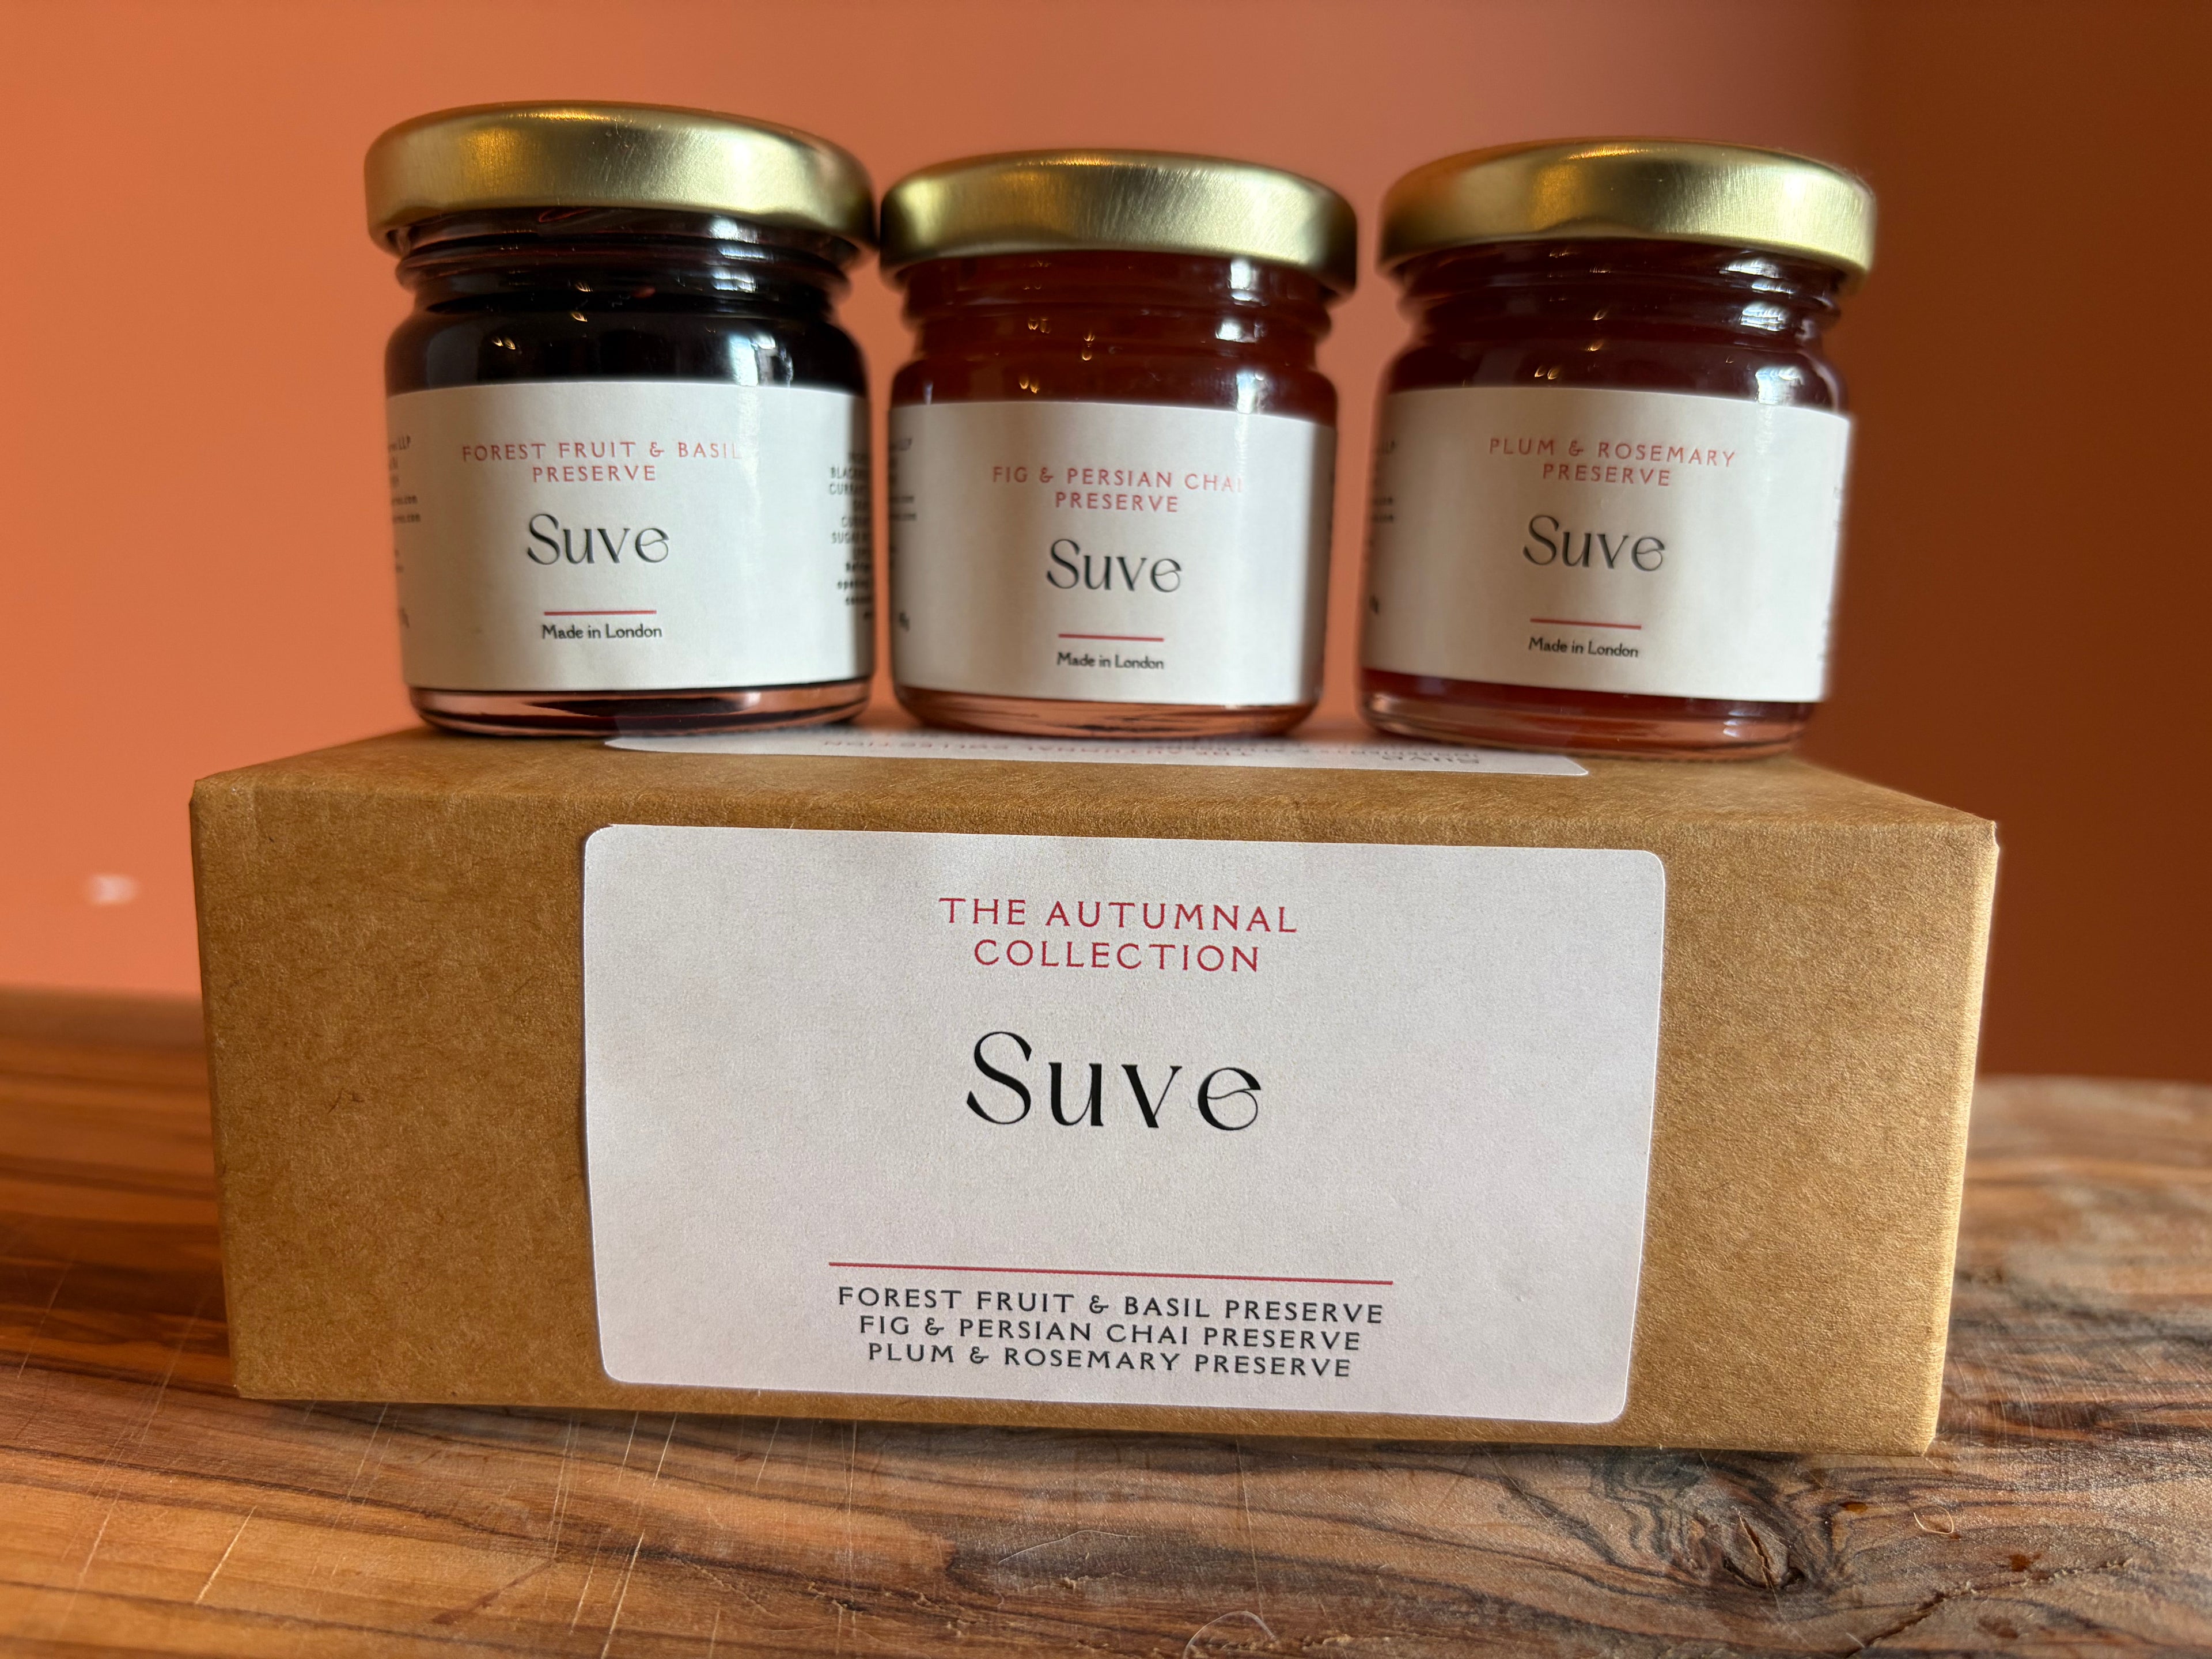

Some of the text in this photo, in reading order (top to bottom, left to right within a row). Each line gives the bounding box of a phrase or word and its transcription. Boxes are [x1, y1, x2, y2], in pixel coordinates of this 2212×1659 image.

[463, 441, 743, 461] FOREST FRUIT & BASIL
[1489, 437, 1735, 467] PLUM & ROSEMARY
[532, 465, 655, 483] PRESERVE
[993, 465, 1243, 493] FIG & PERSIAN CHAI
[1543, 464, 1671, 487] PRESERVE
[1055, 491, 1178, 513] PRESERVE
[527, 513, 669, 565] Suve
[1522, 514, 1666, 572] Suve
[1047, 539, 1182, 593] Suve
[541, 623, 662, 639] Made in London
[1057, 652, 1164, 669] Made in London
[1528, 637, 1639, 658] Made in London
[938, 897, 1297, 933] THE AUTUMNAL
[974, 938, 1259, 972] COLLECTION
[966, 1031, 1262, 1131] Suve
[839, 1286, 1382, 1324] FOREST FRUIT & BASIL PRESERVE
[860, 1315, 1360, 1351] FIG & PERSIAN CHAI PRESERVE
[869, 1342, 1350, 1377] PLUM & ROSEMARY PRESERVE
